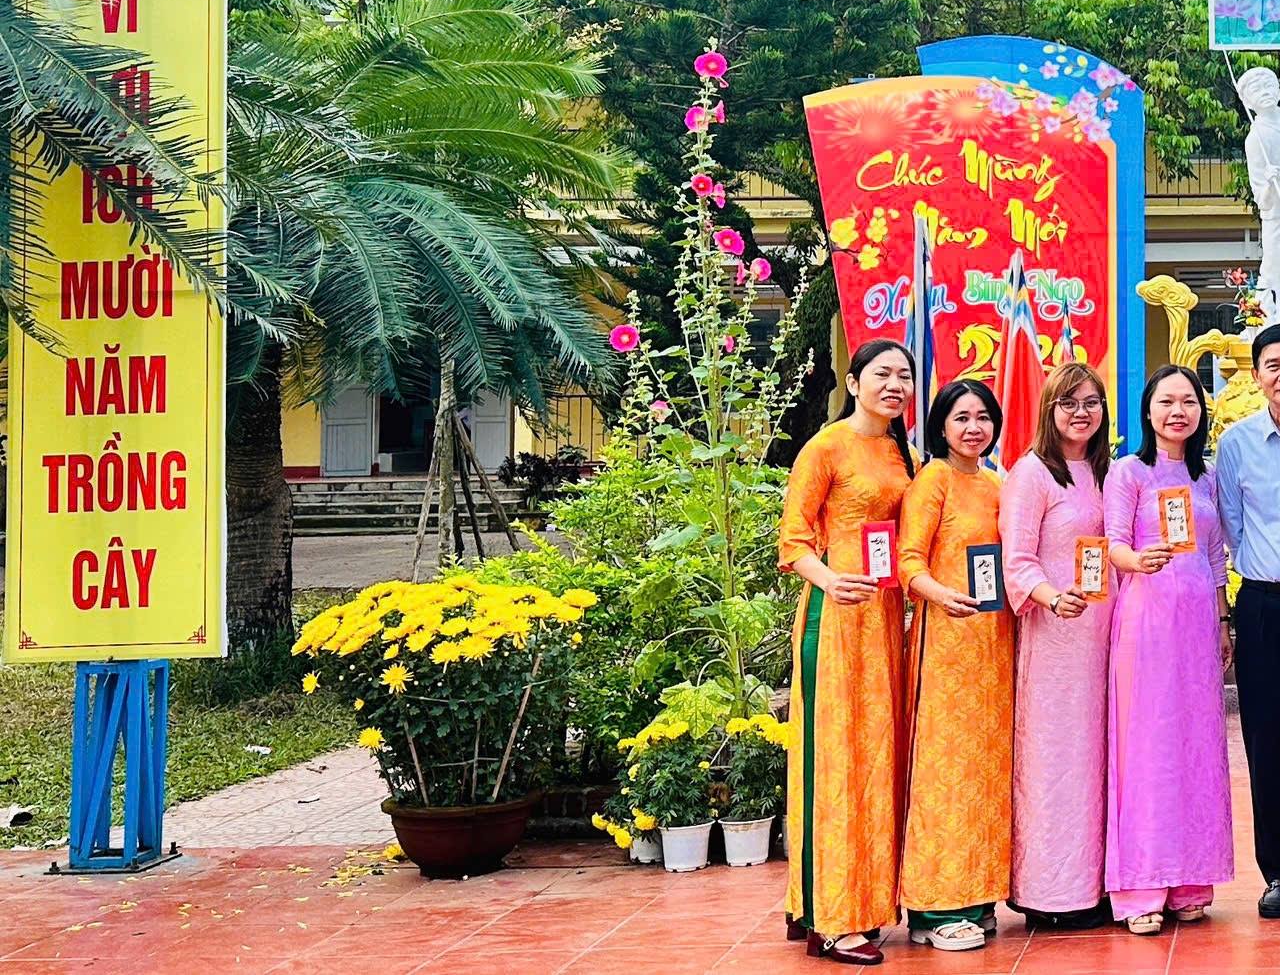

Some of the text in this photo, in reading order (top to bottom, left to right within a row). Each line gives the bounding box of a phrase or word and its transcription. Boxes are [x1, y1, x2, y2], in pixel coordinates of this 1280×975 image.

[855, 138, 1065, 204] Chúc Mừng
[1003, 197, 1069, 261] Mới
[60, 243, 174, 320] MƯỜI
[1025, 268, 1095, 320] Ngọ
[65, 343, 167, 416] NĂM
[42, 432, 188, 514] TRỒNG
[71, 535, 158, 612] CÂY
